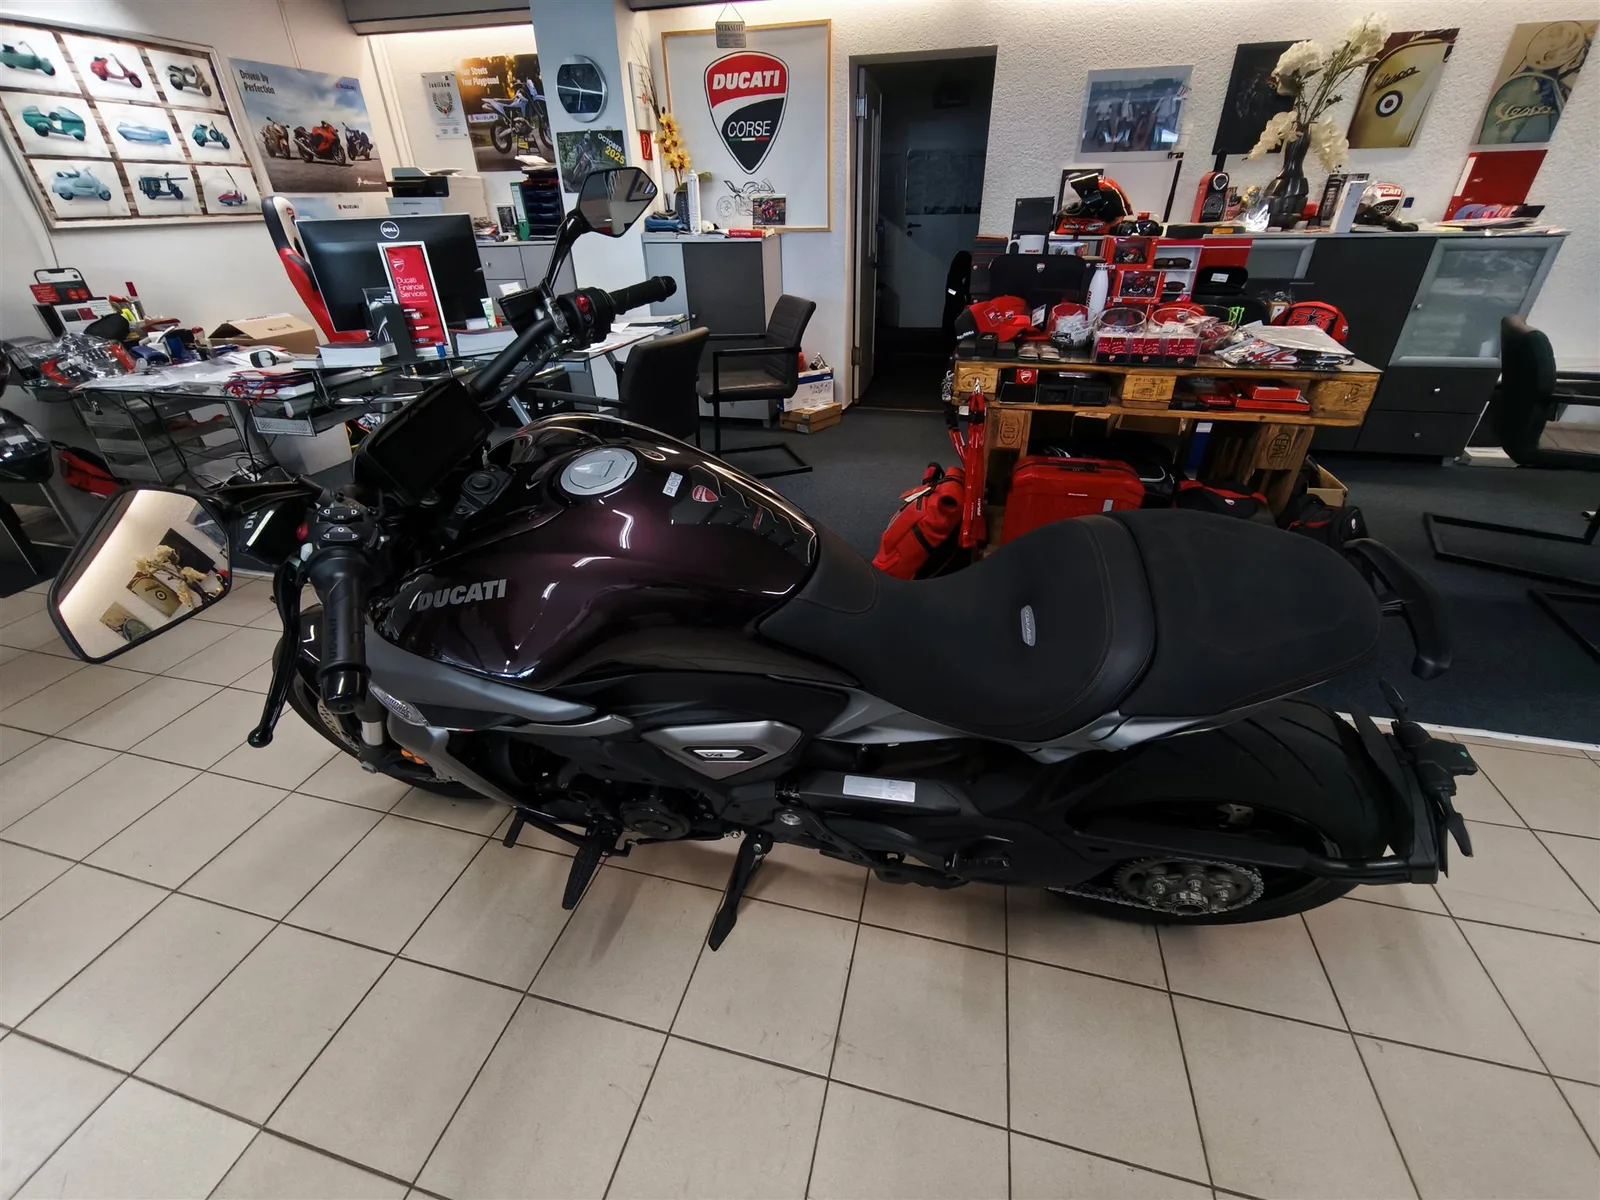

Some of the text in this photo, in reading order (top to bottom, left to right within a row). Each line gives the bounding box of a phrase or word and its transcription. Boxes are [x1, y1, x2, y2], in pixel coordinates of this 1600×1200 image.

[239, 69, 269, 84] Driven by
[712, 70, 780, 90] DUCATI
[243, 81, 275, 95] Perfection
[1495, 103, 1552, 125] Vespa
[727, 120, 772, 137] CORSE
[597, 133, 622, 152] OCTOBER
[604, 145, 626, 165] 2025
[396, 276, 417, 284] Ducati
[398, 283, 424, 291] Financial
[400, 290, 428, 298] Services
[416, 578, 507, 612] DUCATI
